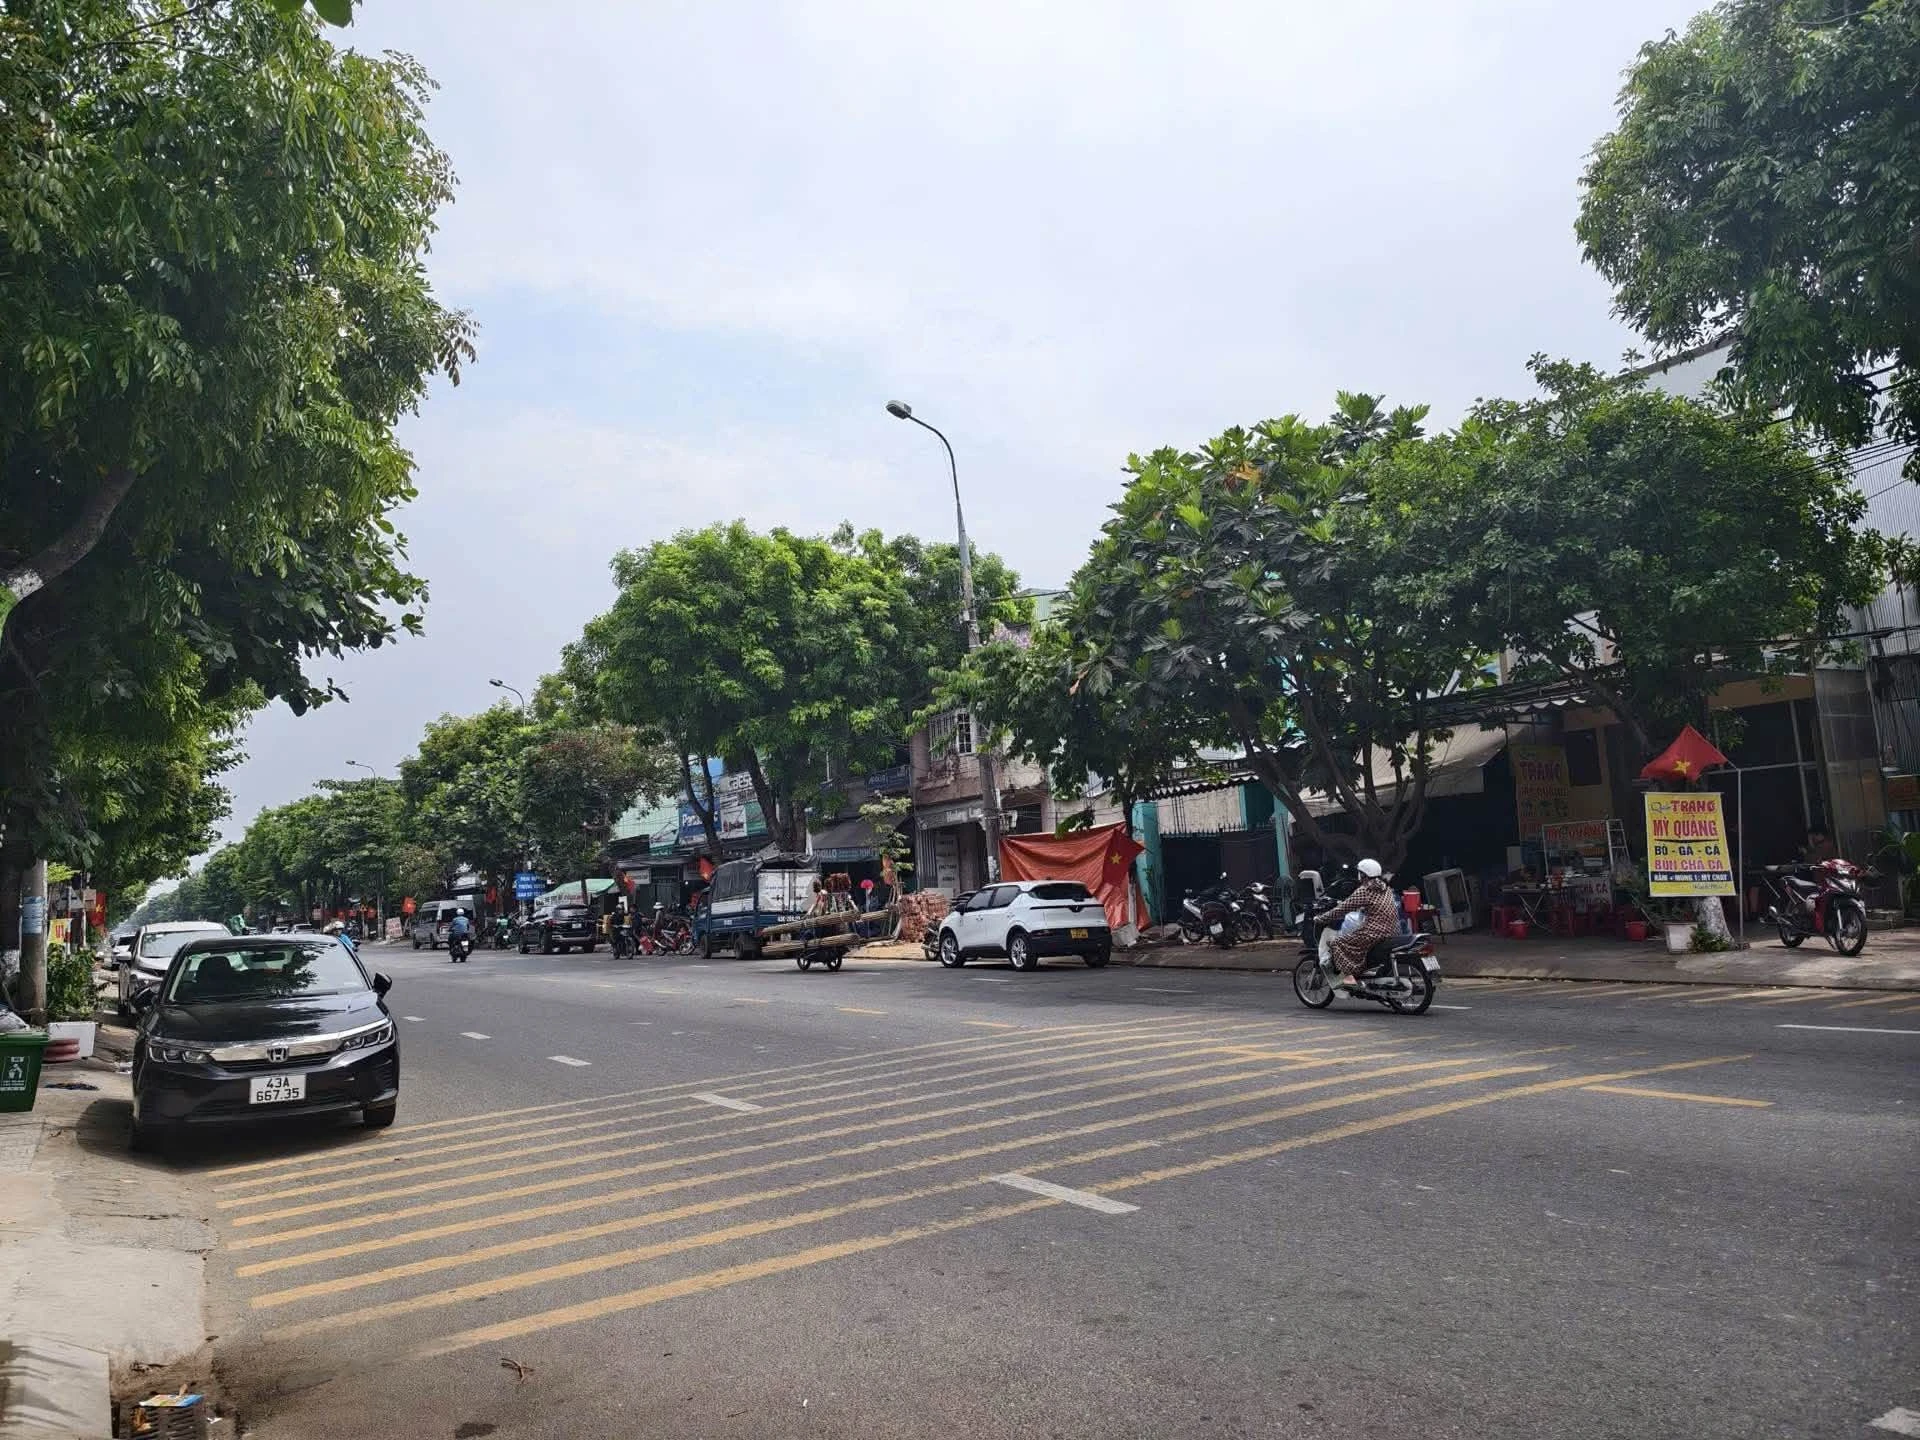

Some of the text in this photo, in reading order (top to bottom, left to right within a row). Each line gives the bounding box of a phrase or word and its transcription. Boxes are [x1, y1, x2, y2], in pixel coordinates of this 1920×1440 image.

[1670, 800, 1716, 813] TRANG
[1673, 814, 1718, 838] QUẢNG
[1654, 843, 1668, 856] BÒ
[266, 1076, 290, 1089] 43A
[256, 1087, 300, 1102] 667.35
